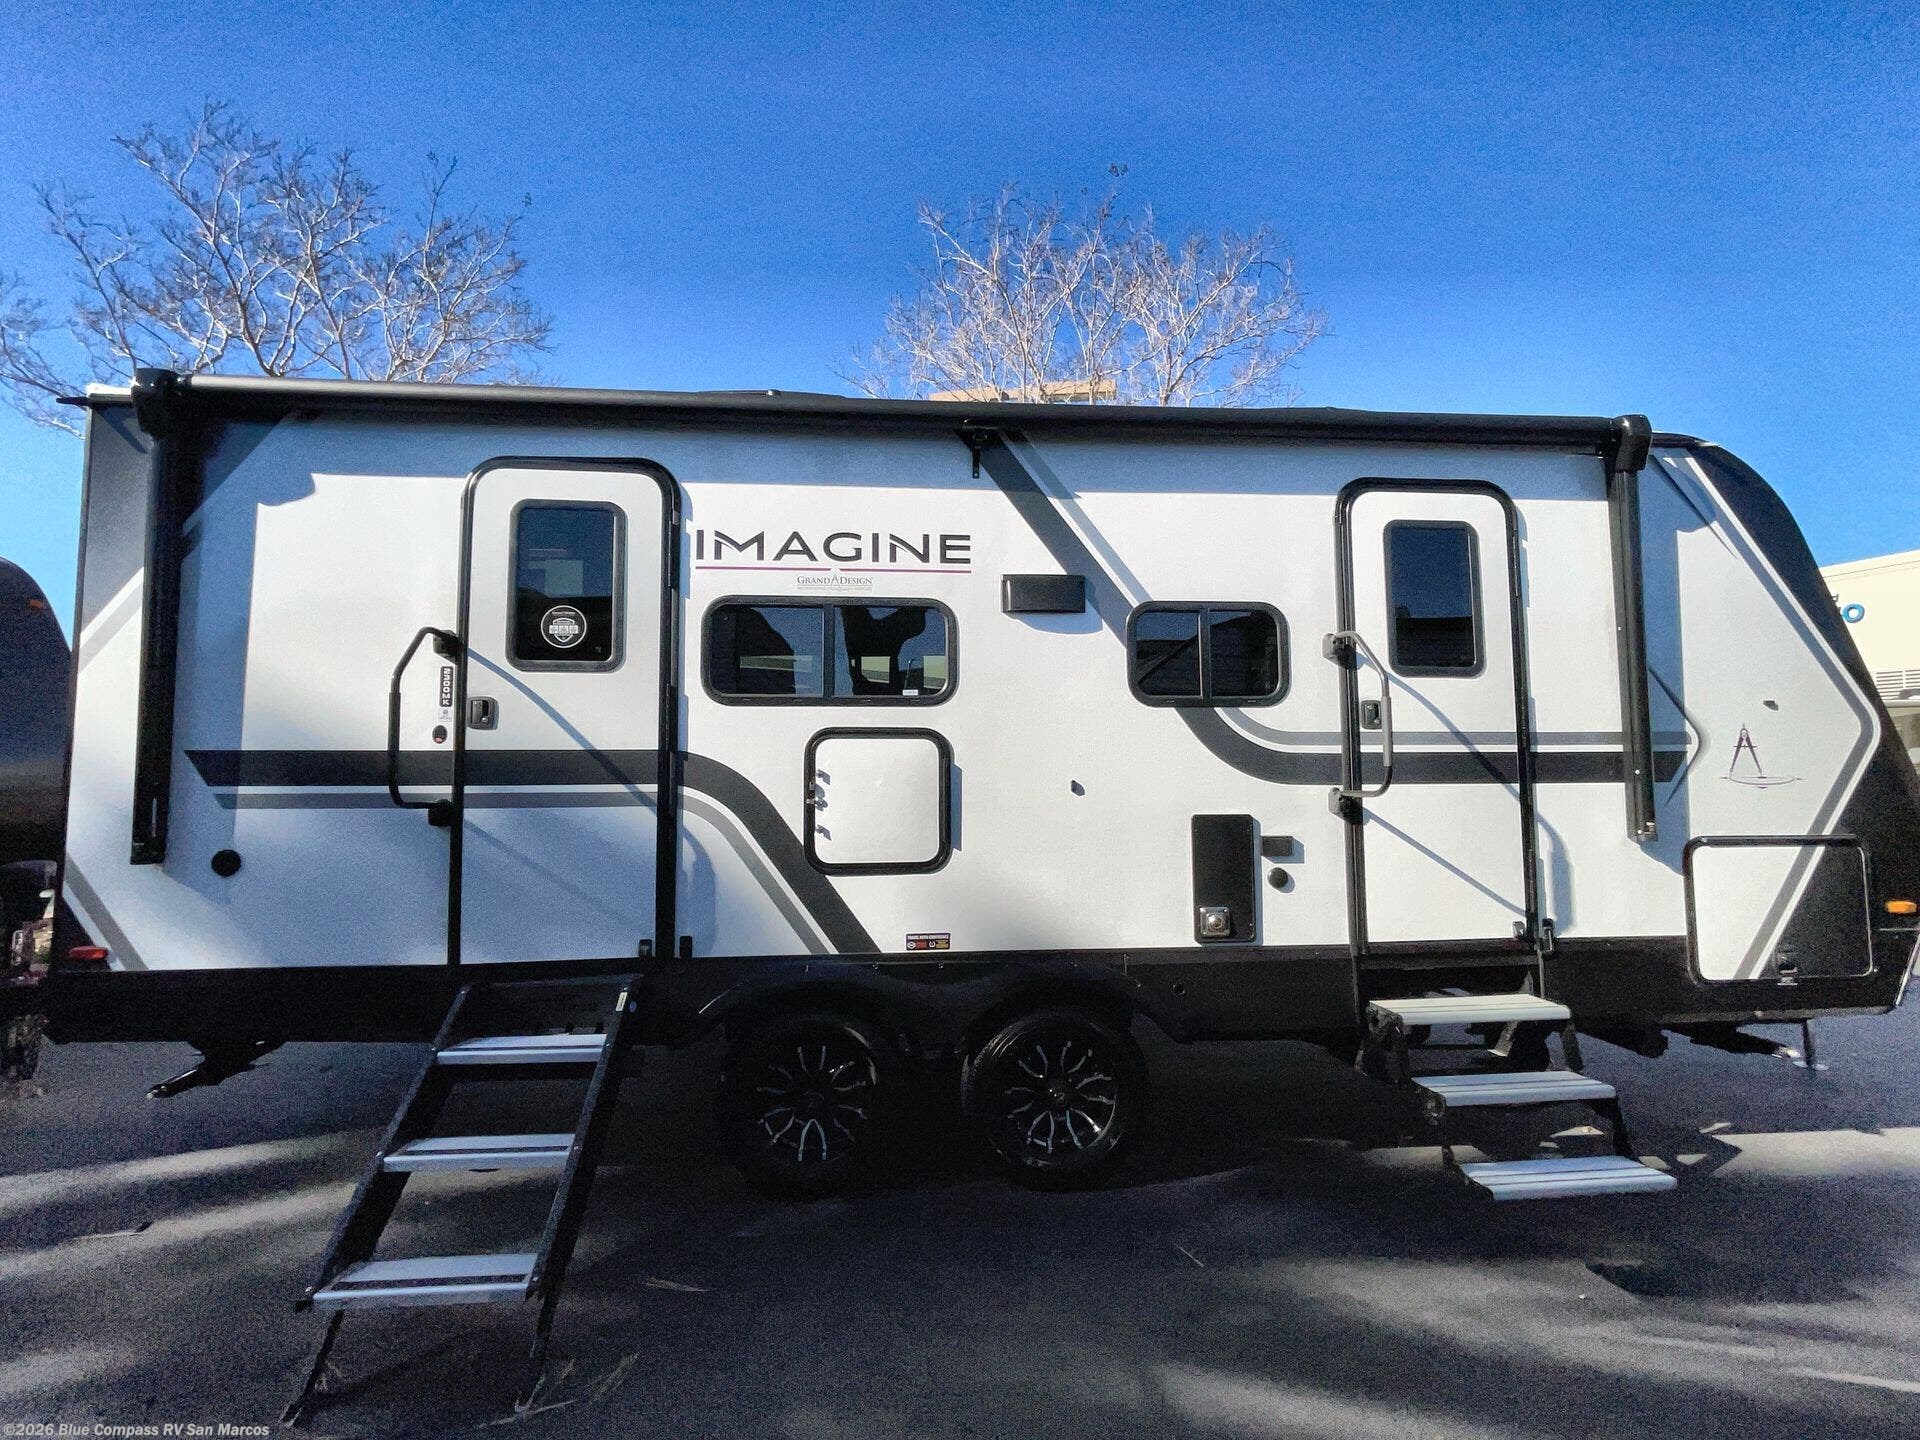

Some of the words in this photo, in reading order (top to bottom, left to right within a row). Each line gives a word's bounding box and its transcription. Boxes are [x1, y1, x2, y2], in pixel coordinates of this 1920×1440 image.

[696, 529, 972, 565] IMAGINE
[797, 575, 831, 585] GRAND
[840, 576, 873, 586] DESIGN
